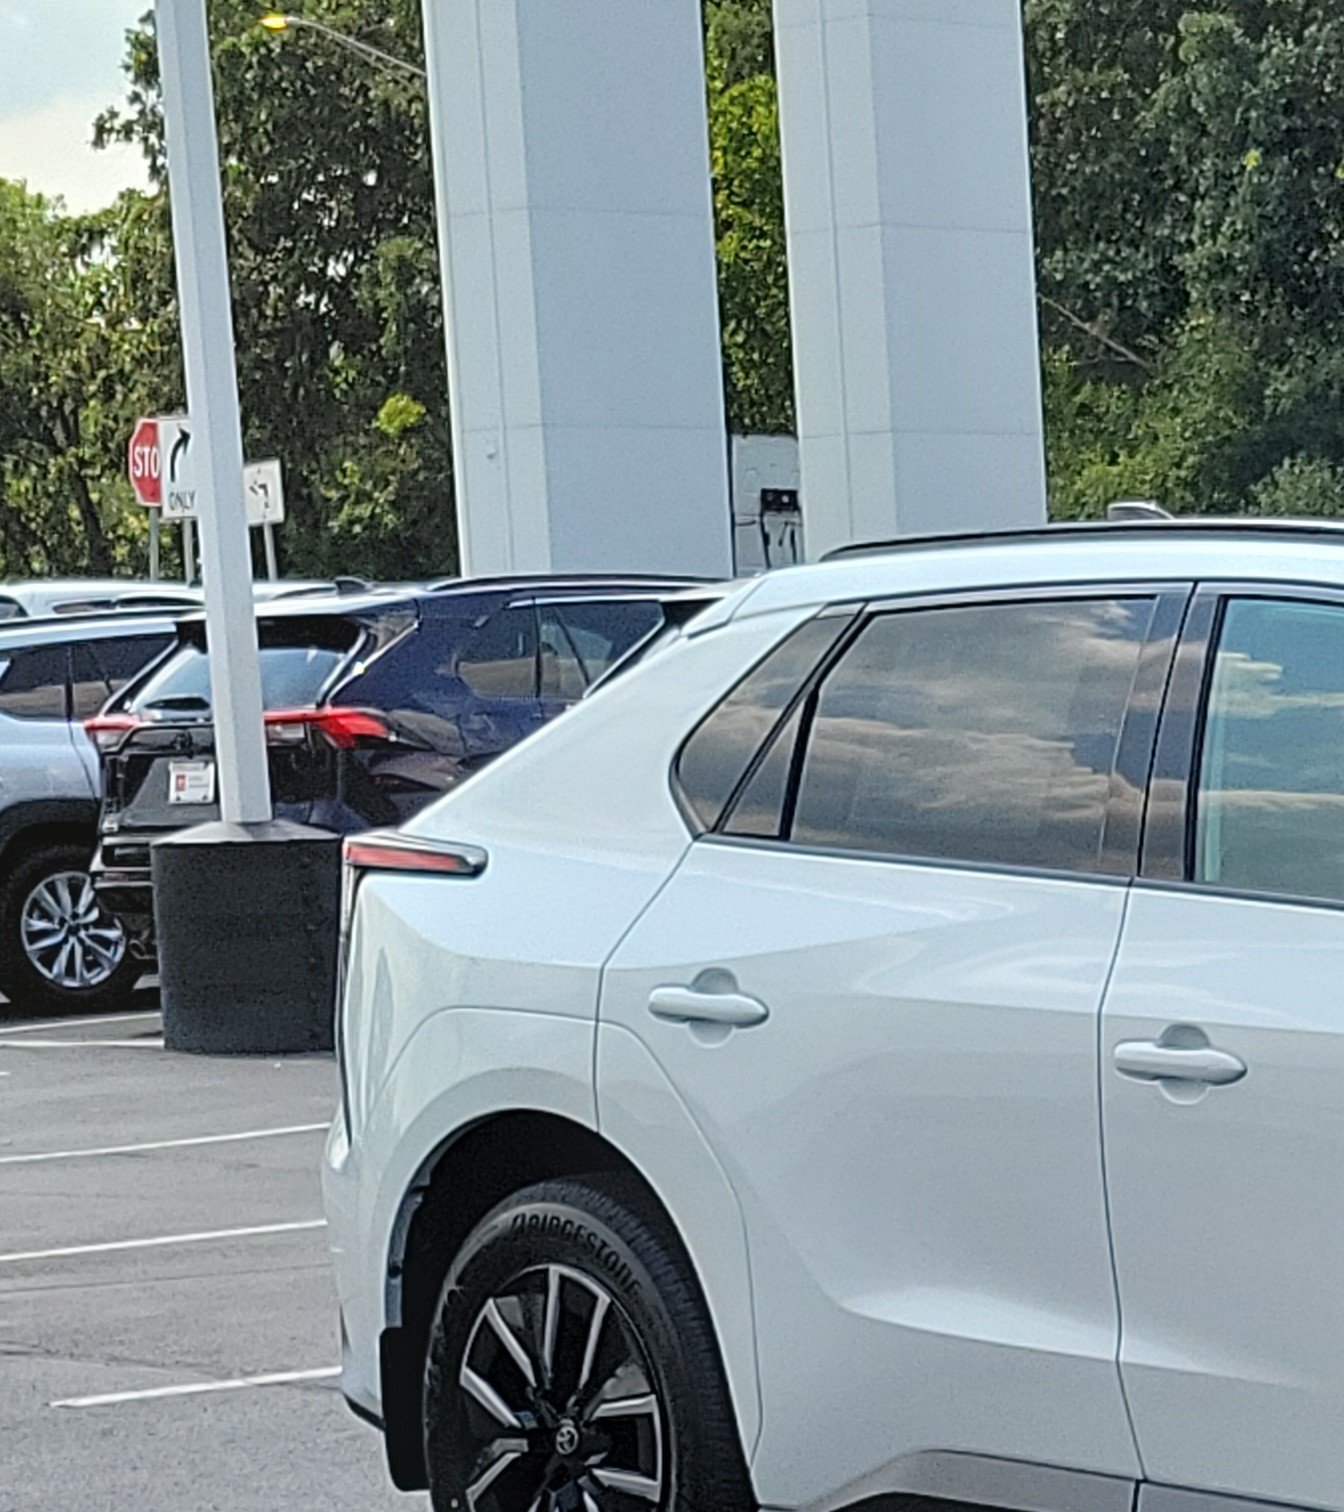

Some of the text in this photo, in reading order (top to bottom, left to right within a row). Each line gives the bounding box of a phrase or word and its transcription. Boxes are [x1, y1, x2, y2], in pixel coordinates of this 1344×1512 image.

[133, 444, 162, 479] STO
[168, 490, 196, 511] ONLY
[511, 1211, 644, 1298] BRIDGESTONE
